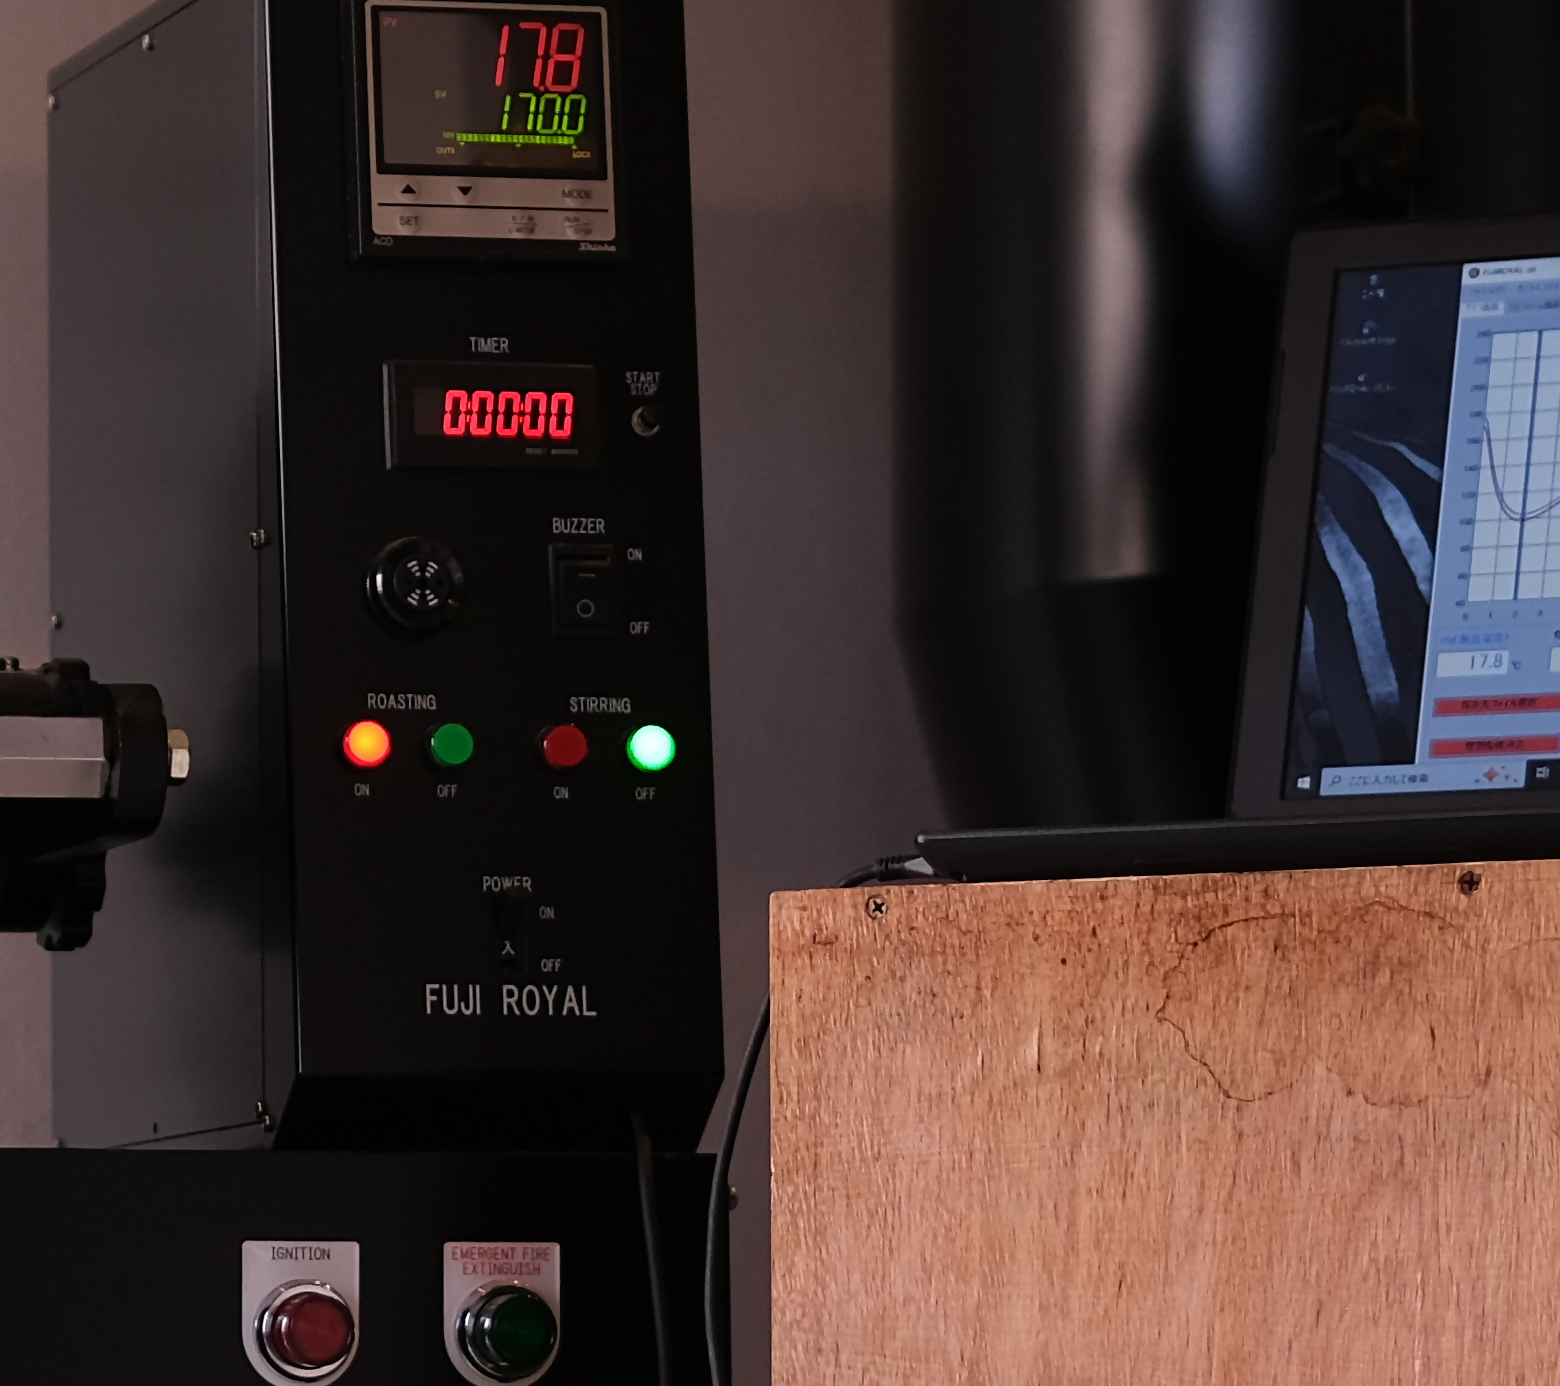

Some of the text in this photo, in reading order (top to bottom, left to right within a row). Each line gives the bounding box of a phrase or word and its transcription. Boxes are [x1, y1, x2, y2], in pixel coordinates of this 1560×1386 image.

[494, 21, 585, 93] 17.8
[561, 189, 593, 201] MODE
[398, 215, 420, 227] SET
[469, 337, 510, 354] TIMER
[625, 371, 661, 384] START
[630, 383, 658, 396] STOP
[552, 517, 606, 535] BUZZER
[626, 547, 643, 561] ON
[629, 620, 650, 635] OFF
[367, 693, 437, 710] ROASTING
[569, 696, 632, 714] STIRRING
[353, 782, 370, 797] ON
[436, 784, 459, 799] OFF
[553, 785, 569, 801] ON
[635, 787, 656, 801] OFF
[482, 876, 532, 893] POWER
[538, 905, 555, 920] ON
[540, 958, 562, 973] OFF
[424, 983, 598, 1017] FUJI ROYAL
[271, 1245, 331, 1261] IGNITION
[451, 1245, 551, 1262] EMERGENT FIRE
[462, 1261, 541, 1277] EXTINGUISH
